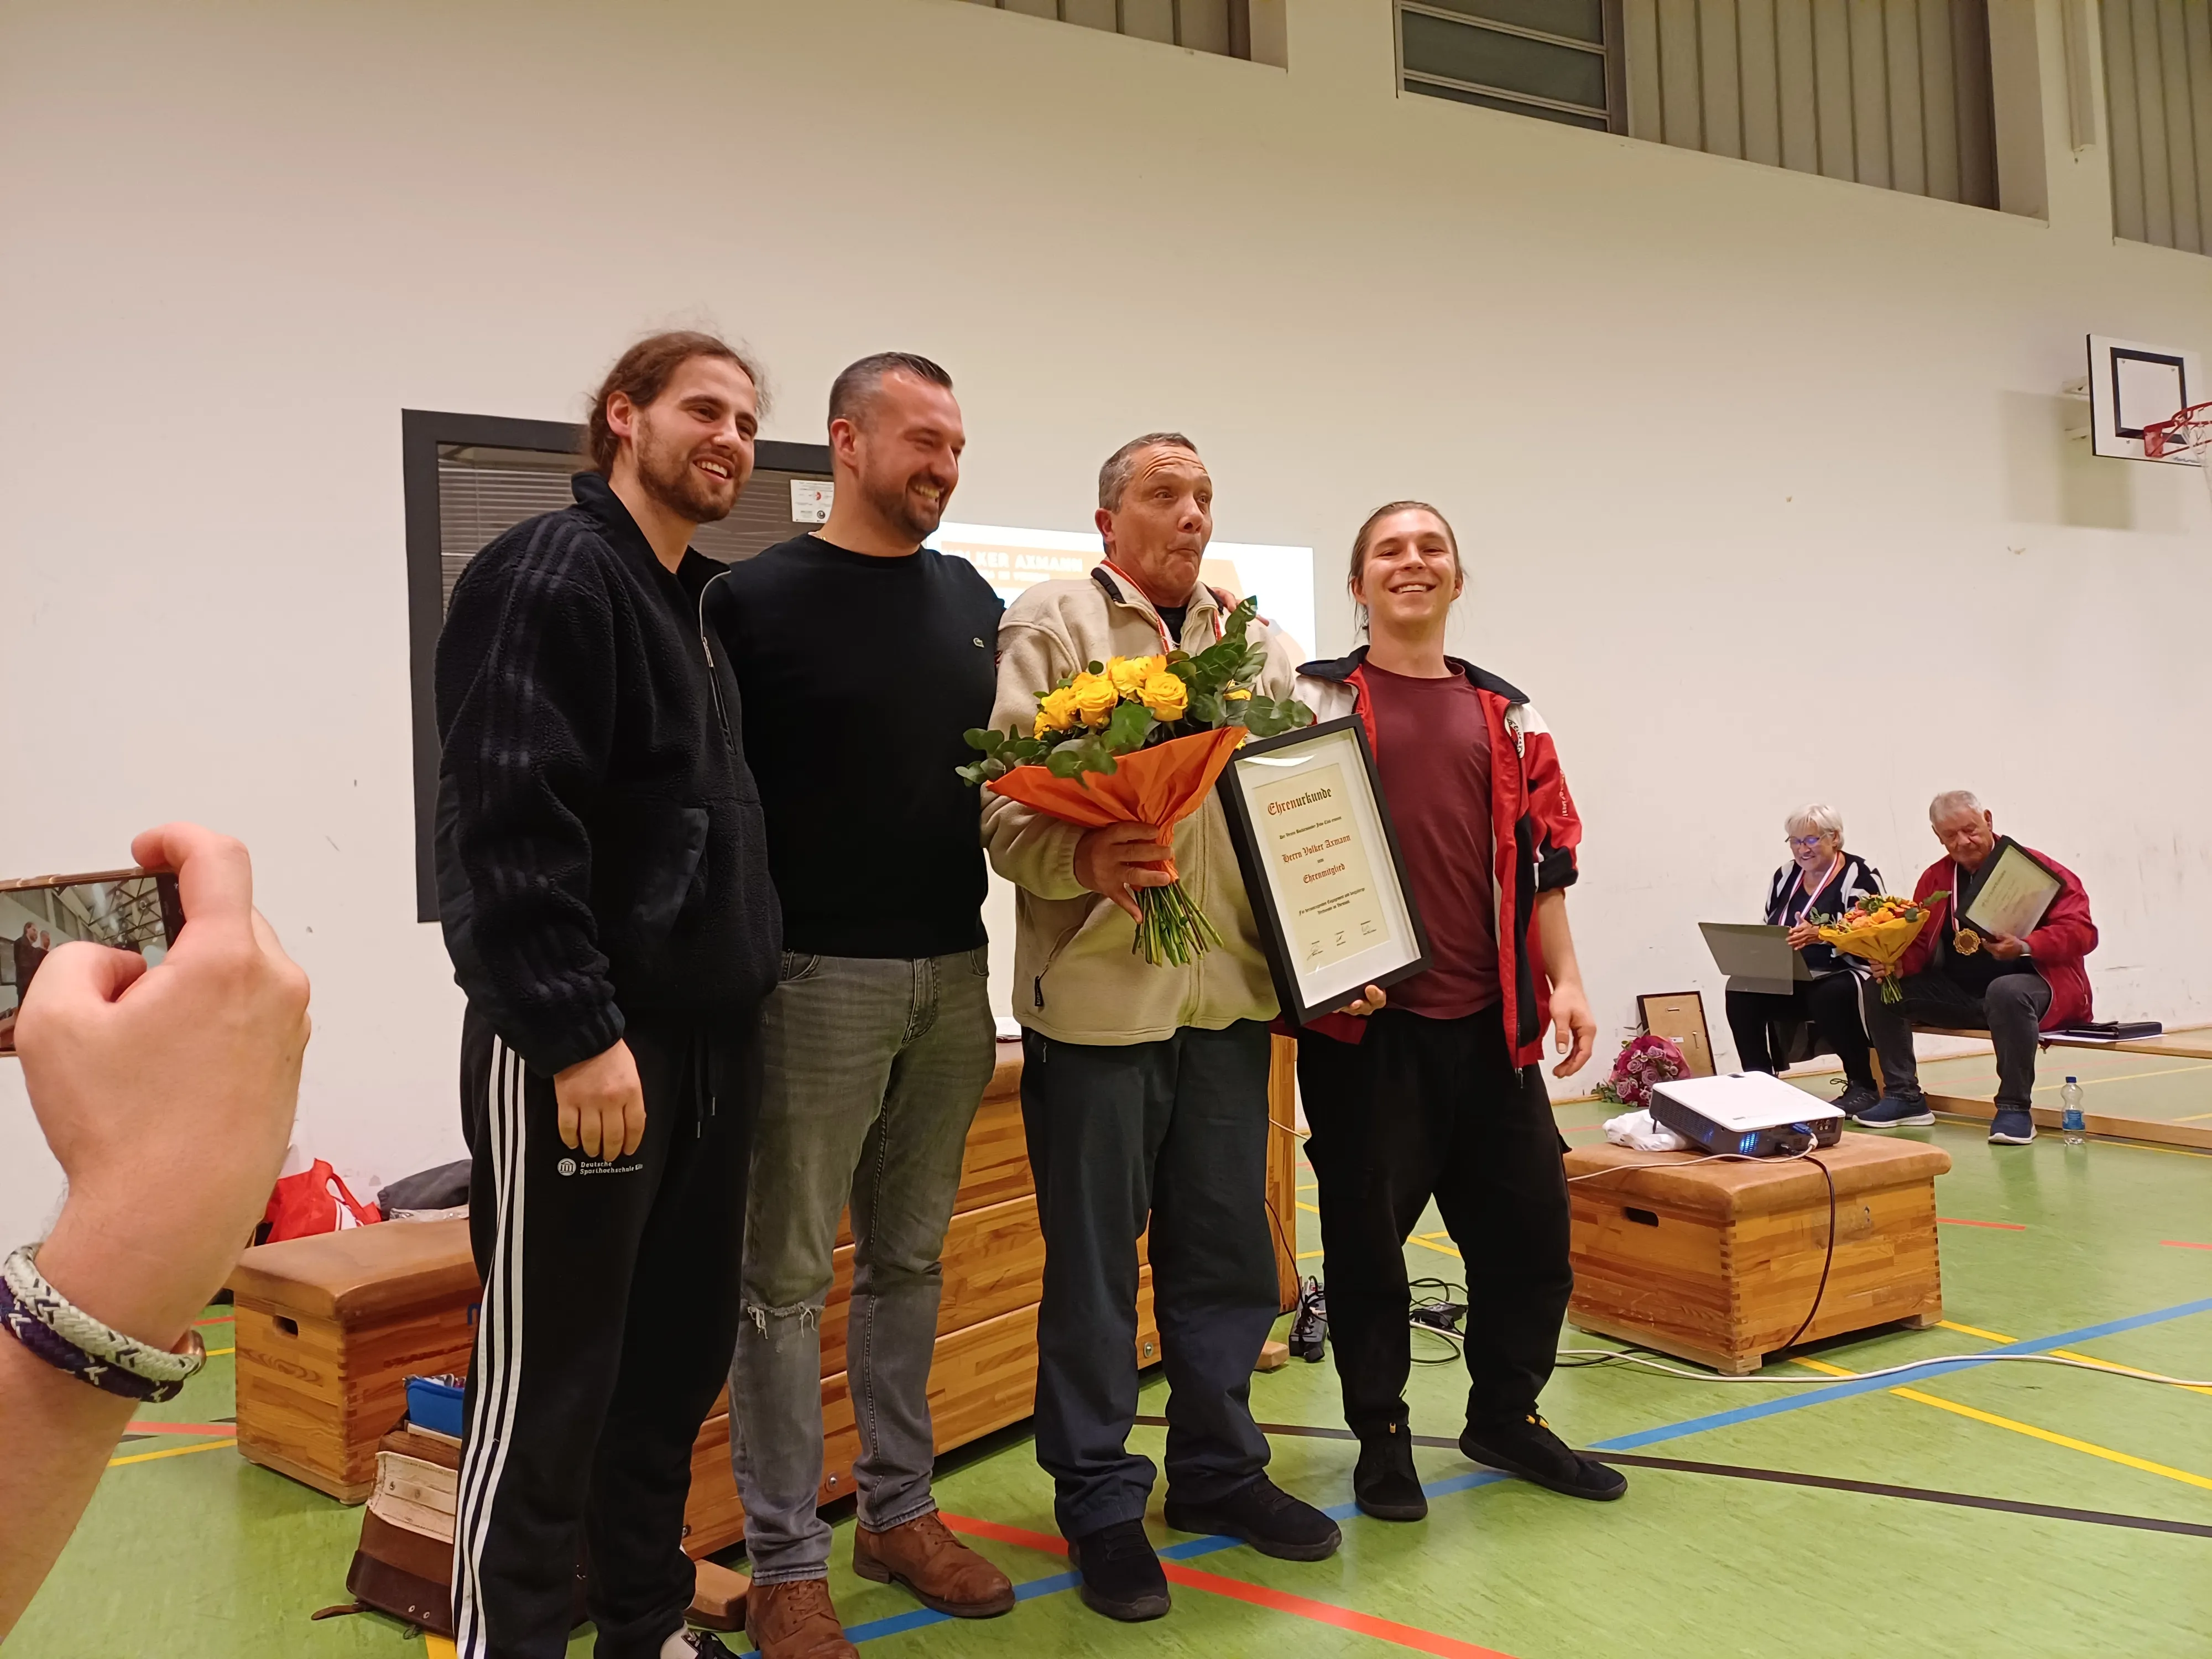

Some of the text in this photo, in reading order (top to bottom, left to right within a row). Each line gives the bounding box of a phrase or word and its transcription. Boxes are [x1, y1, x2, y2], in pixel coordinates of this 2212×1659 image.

[1015, 554, 1083, 572] AXMANN
[1267, 788, 1332, 816] Ehrenurkunde
[1282, 834, 1351, 863] Herrn Volker Axmann
[1303, 863, 1345, 884] Ehrenmitglied
[580, 1166, 634, 1176] Sporthochschule
